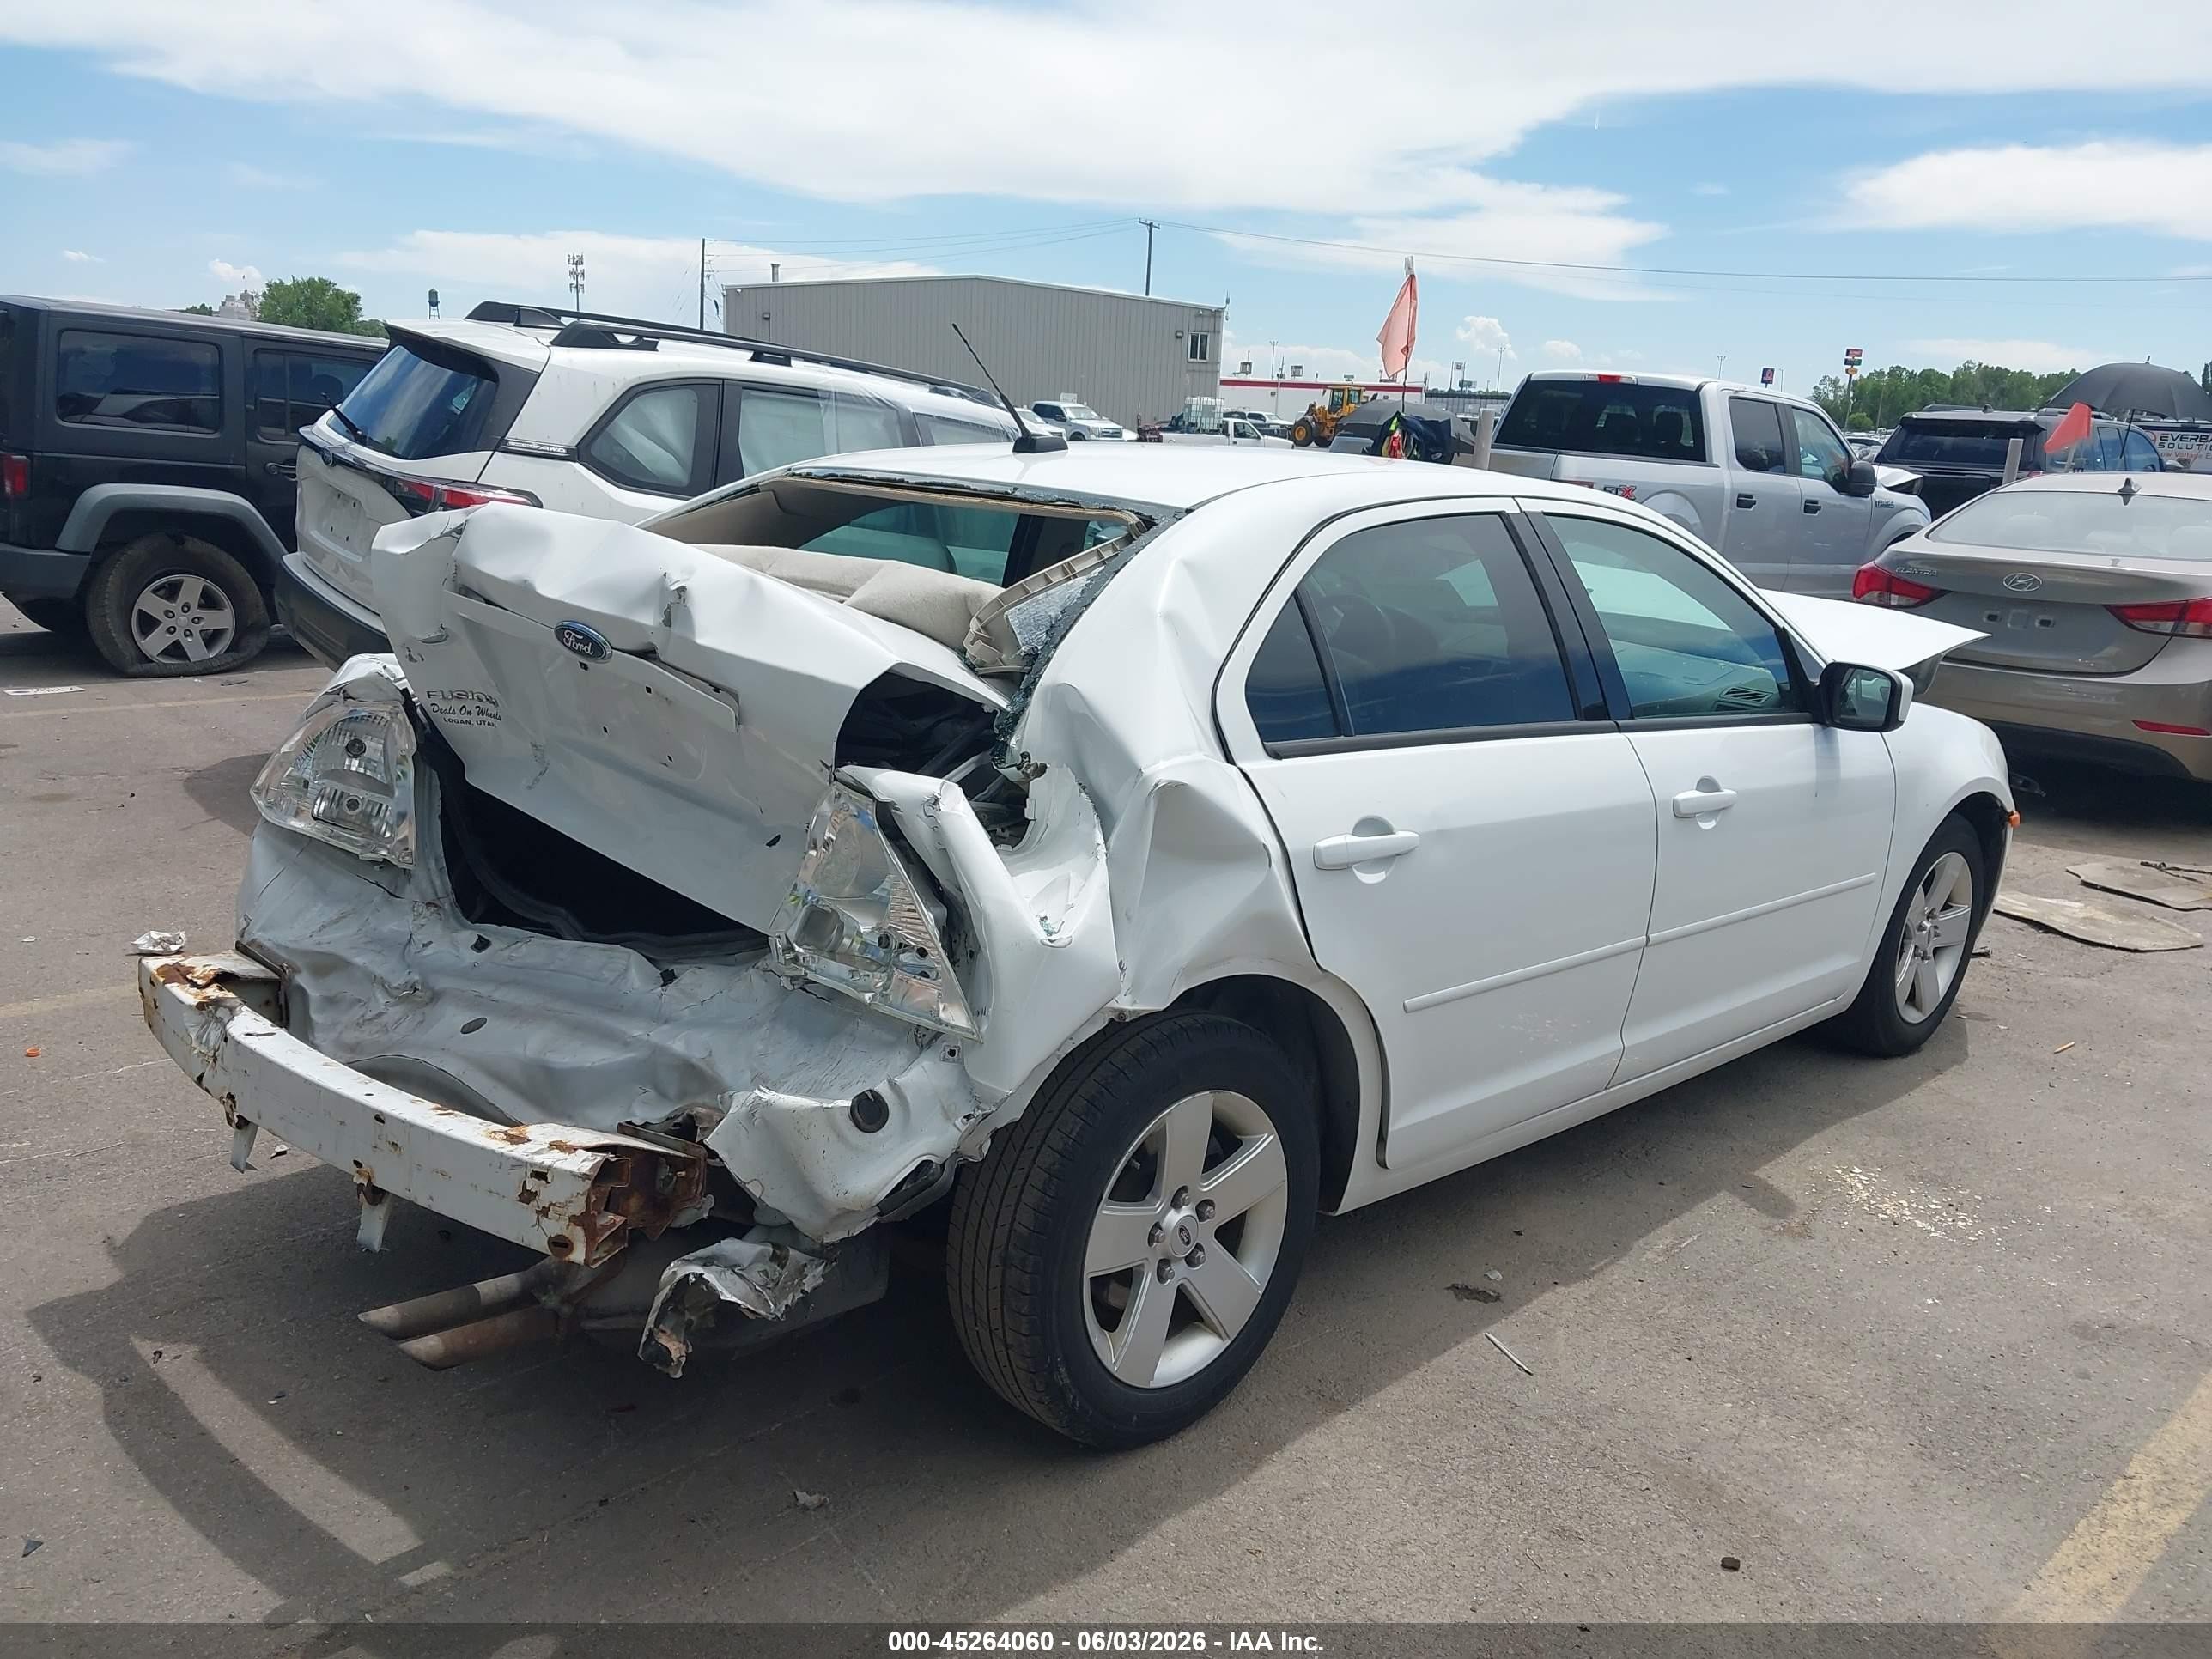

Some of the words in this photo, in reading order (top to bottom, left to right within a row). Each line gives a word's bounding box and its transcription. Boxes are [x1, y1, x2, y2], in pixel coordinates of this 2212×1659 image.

[563, 629, 593, 655] Ford
[426, 690, 499, 708] FUSION
[430, 702, 456, 715] Deals
[459, 705, 473, 715] On
[475, 705, 502, 721] Wheels
[476, 720, 497, 728] UTAH
